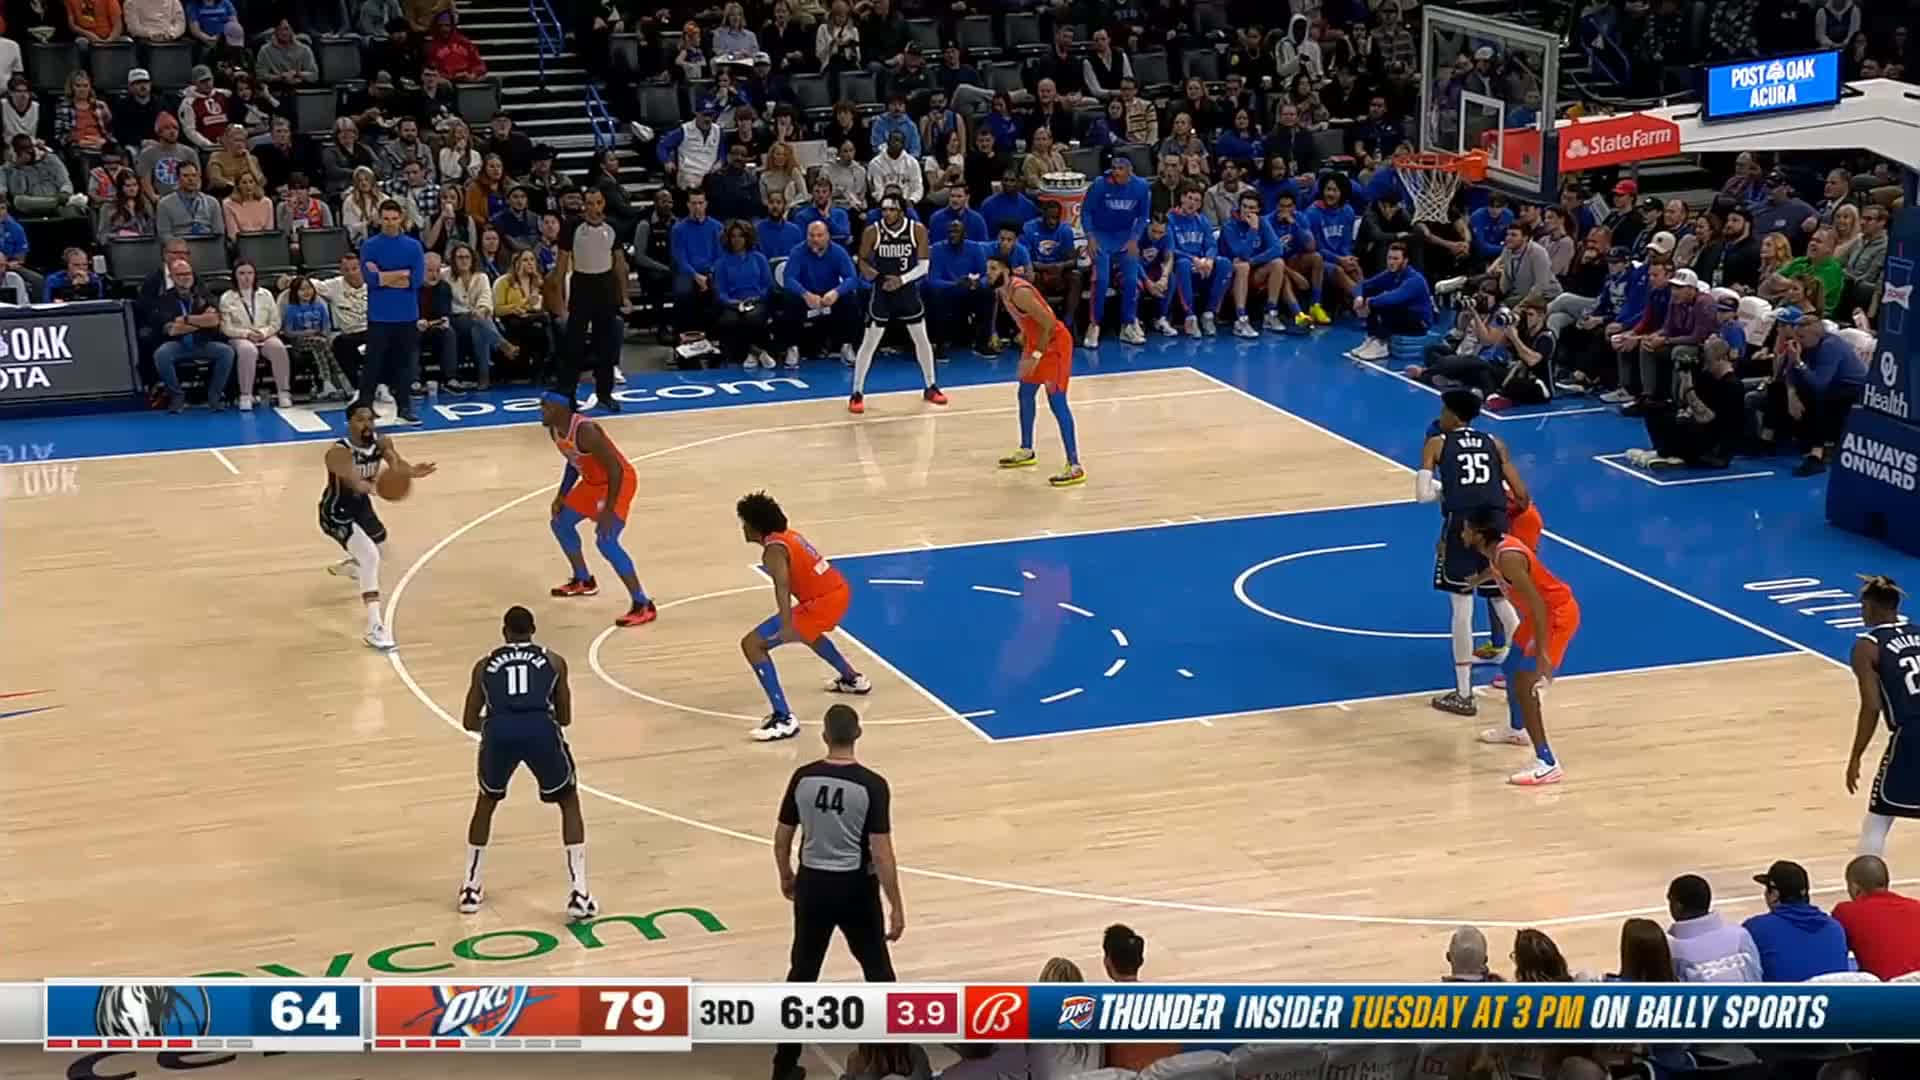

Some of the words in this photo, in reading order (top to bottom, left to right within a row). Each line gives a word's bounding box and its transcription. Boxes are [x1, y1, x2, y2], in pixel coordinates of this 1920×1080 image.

[1731, 64, 1766, 89] POST
[1786, 57, 1816, 81] OAK
[1749, 83, 1798, 108] ACURA
[900, 257, 909, 271] 3
[11, 324, 72, 361] OAK
[1863, 383, 1909, 418] Health
[1456, 452, 1490, 485] 35
[1841, 432, 1919, 474] ALWAYS
[1840, 451, 1916, 491] ONWARD
[504, 664, 529, 696] 11
[814, 785, 844, 815] 44
